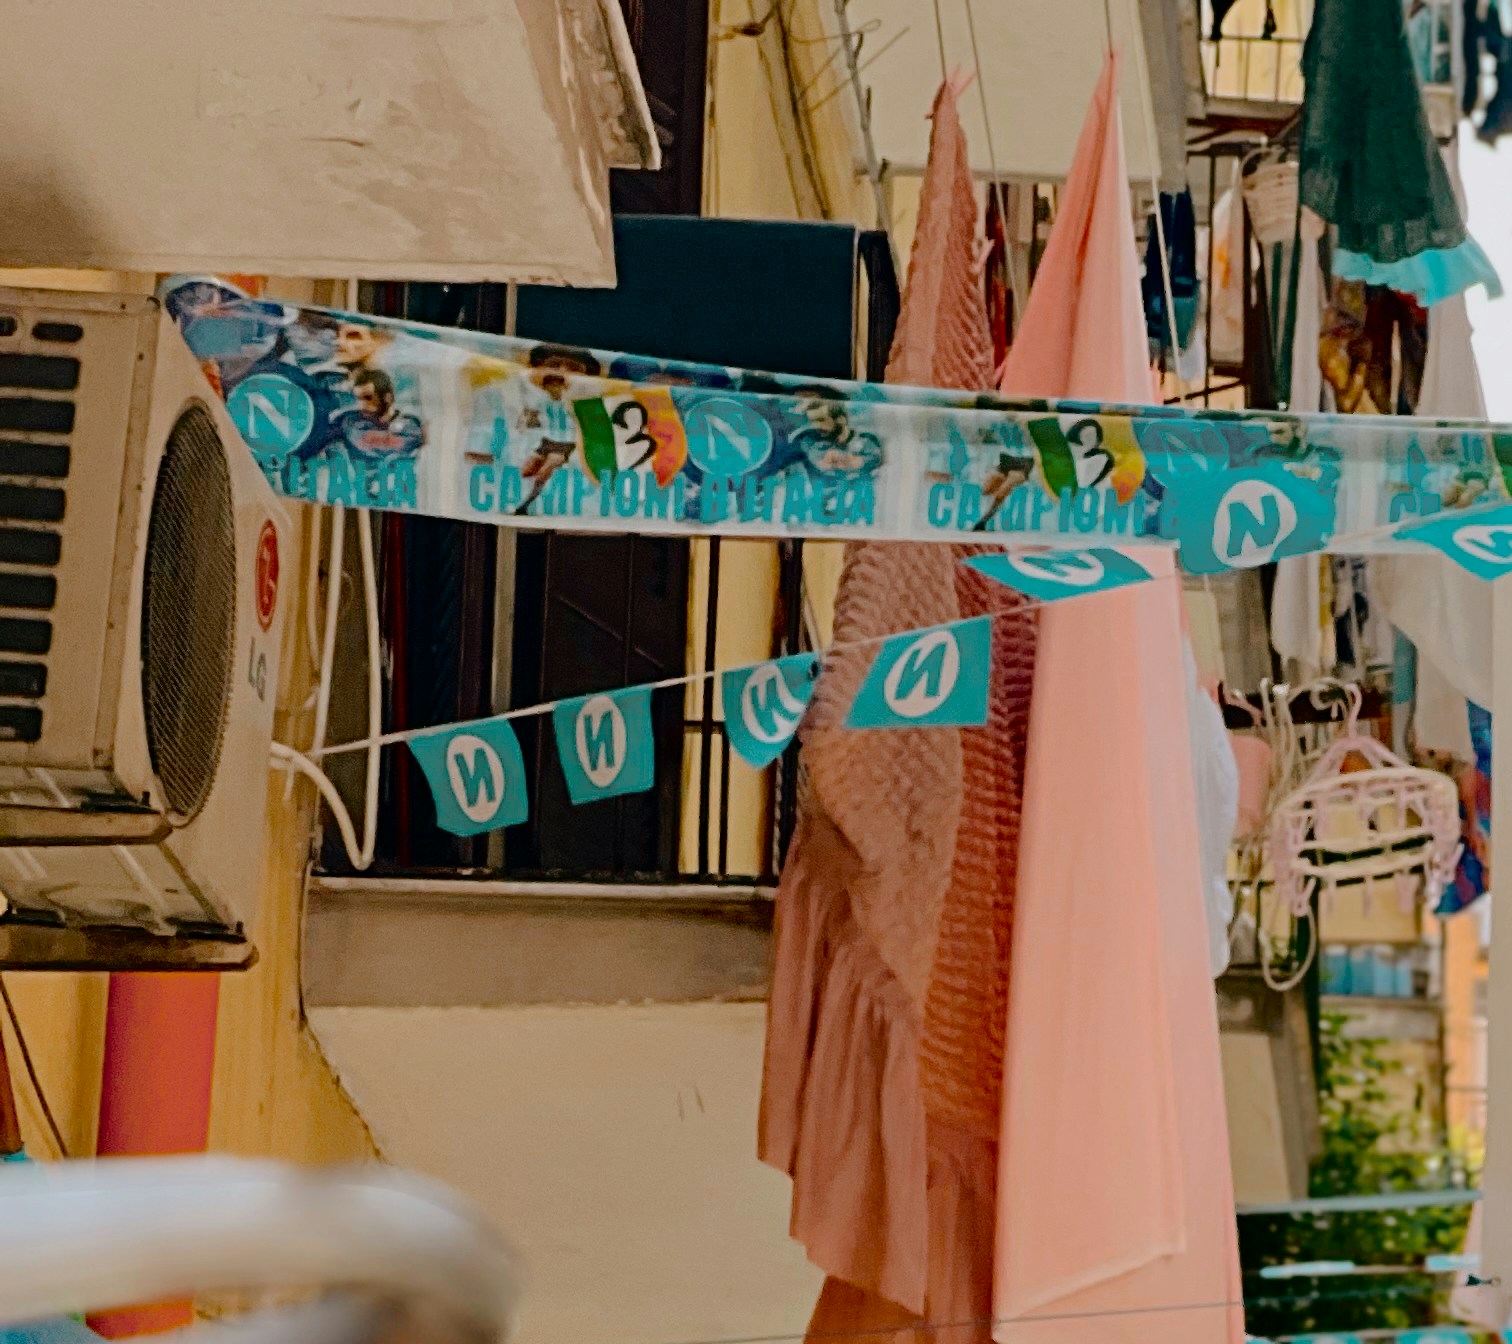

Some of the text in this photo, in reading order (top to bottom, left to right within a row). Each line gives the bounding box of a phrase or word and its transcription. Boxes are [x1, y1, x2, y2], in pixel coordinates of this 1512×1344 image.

[244, 389, 292, 439] N
[611, 401, 658, 471] 3
[704, 413, 751, 460] N
[1066, 418, 1115, 488] 3
